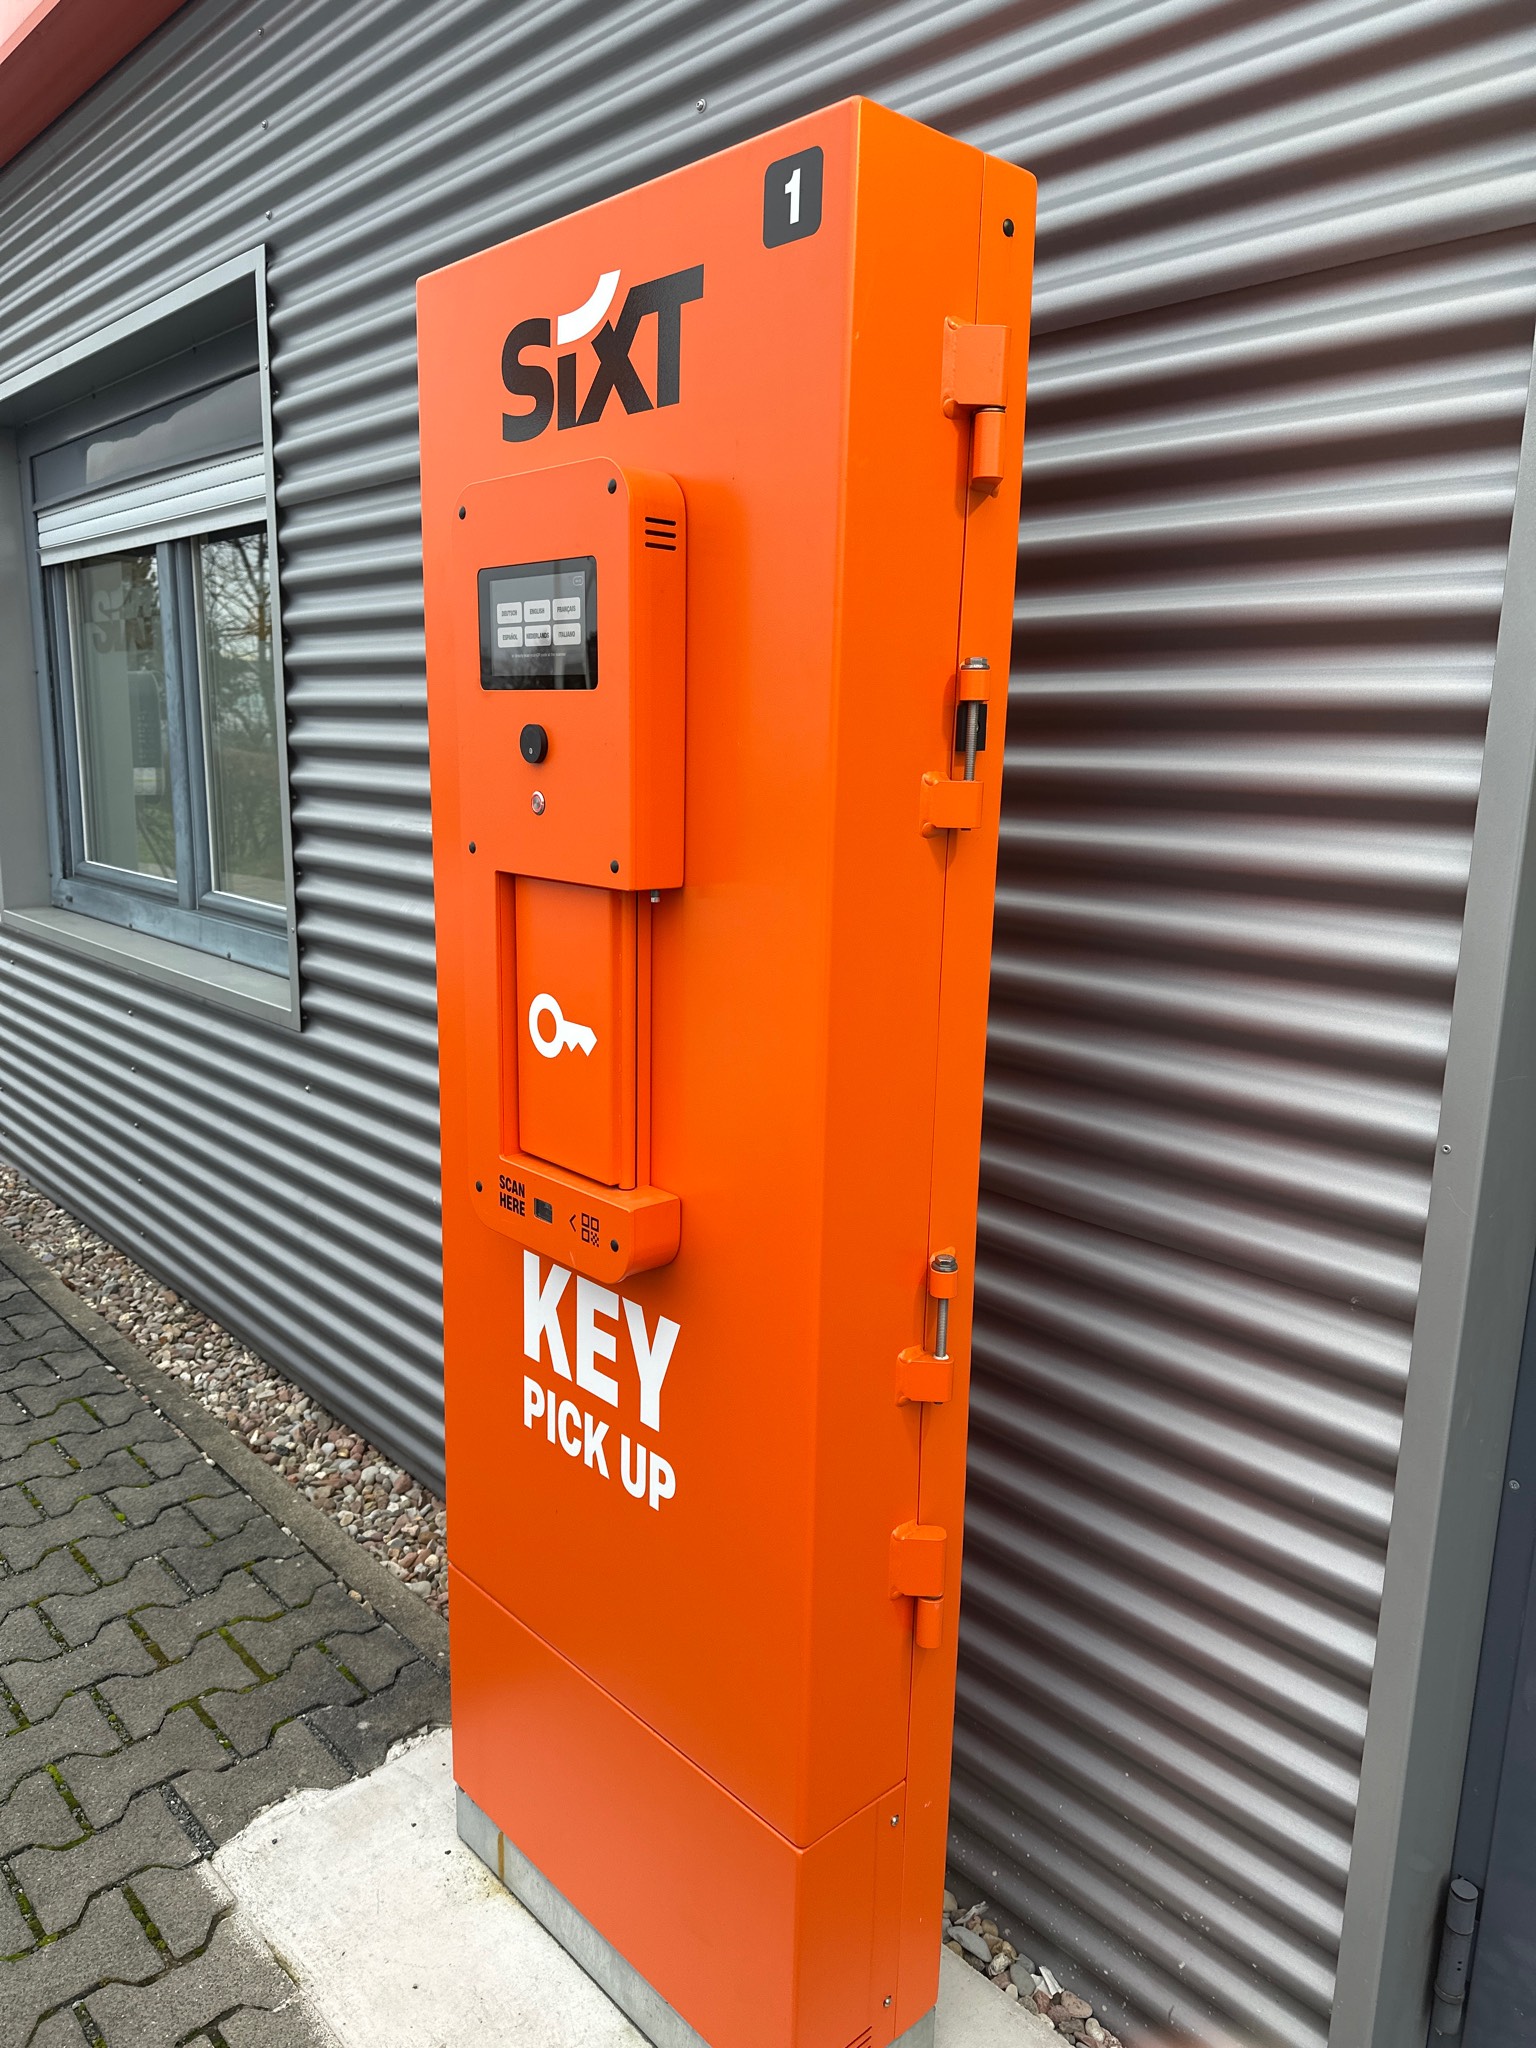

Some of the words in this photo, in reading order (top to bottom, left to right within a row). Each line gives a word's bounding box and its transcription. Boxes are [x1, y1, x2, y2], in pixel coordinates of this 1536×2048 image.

[785, 168, 801, 225] 1
[501, 264, 704, 442] SIXT
[556, 605, 576, 614] FRANÇAIS
[502, 633, 518, 641] ESPAÑOL
[499, 1174, 525, 1198] SCAN
[499, 1191, 525, 1217] HERE
[523, 1249, 681, 1433] KEY
[523, 1374, 610, 1480] PICK
[620, 1433, 676, 1512] UP
